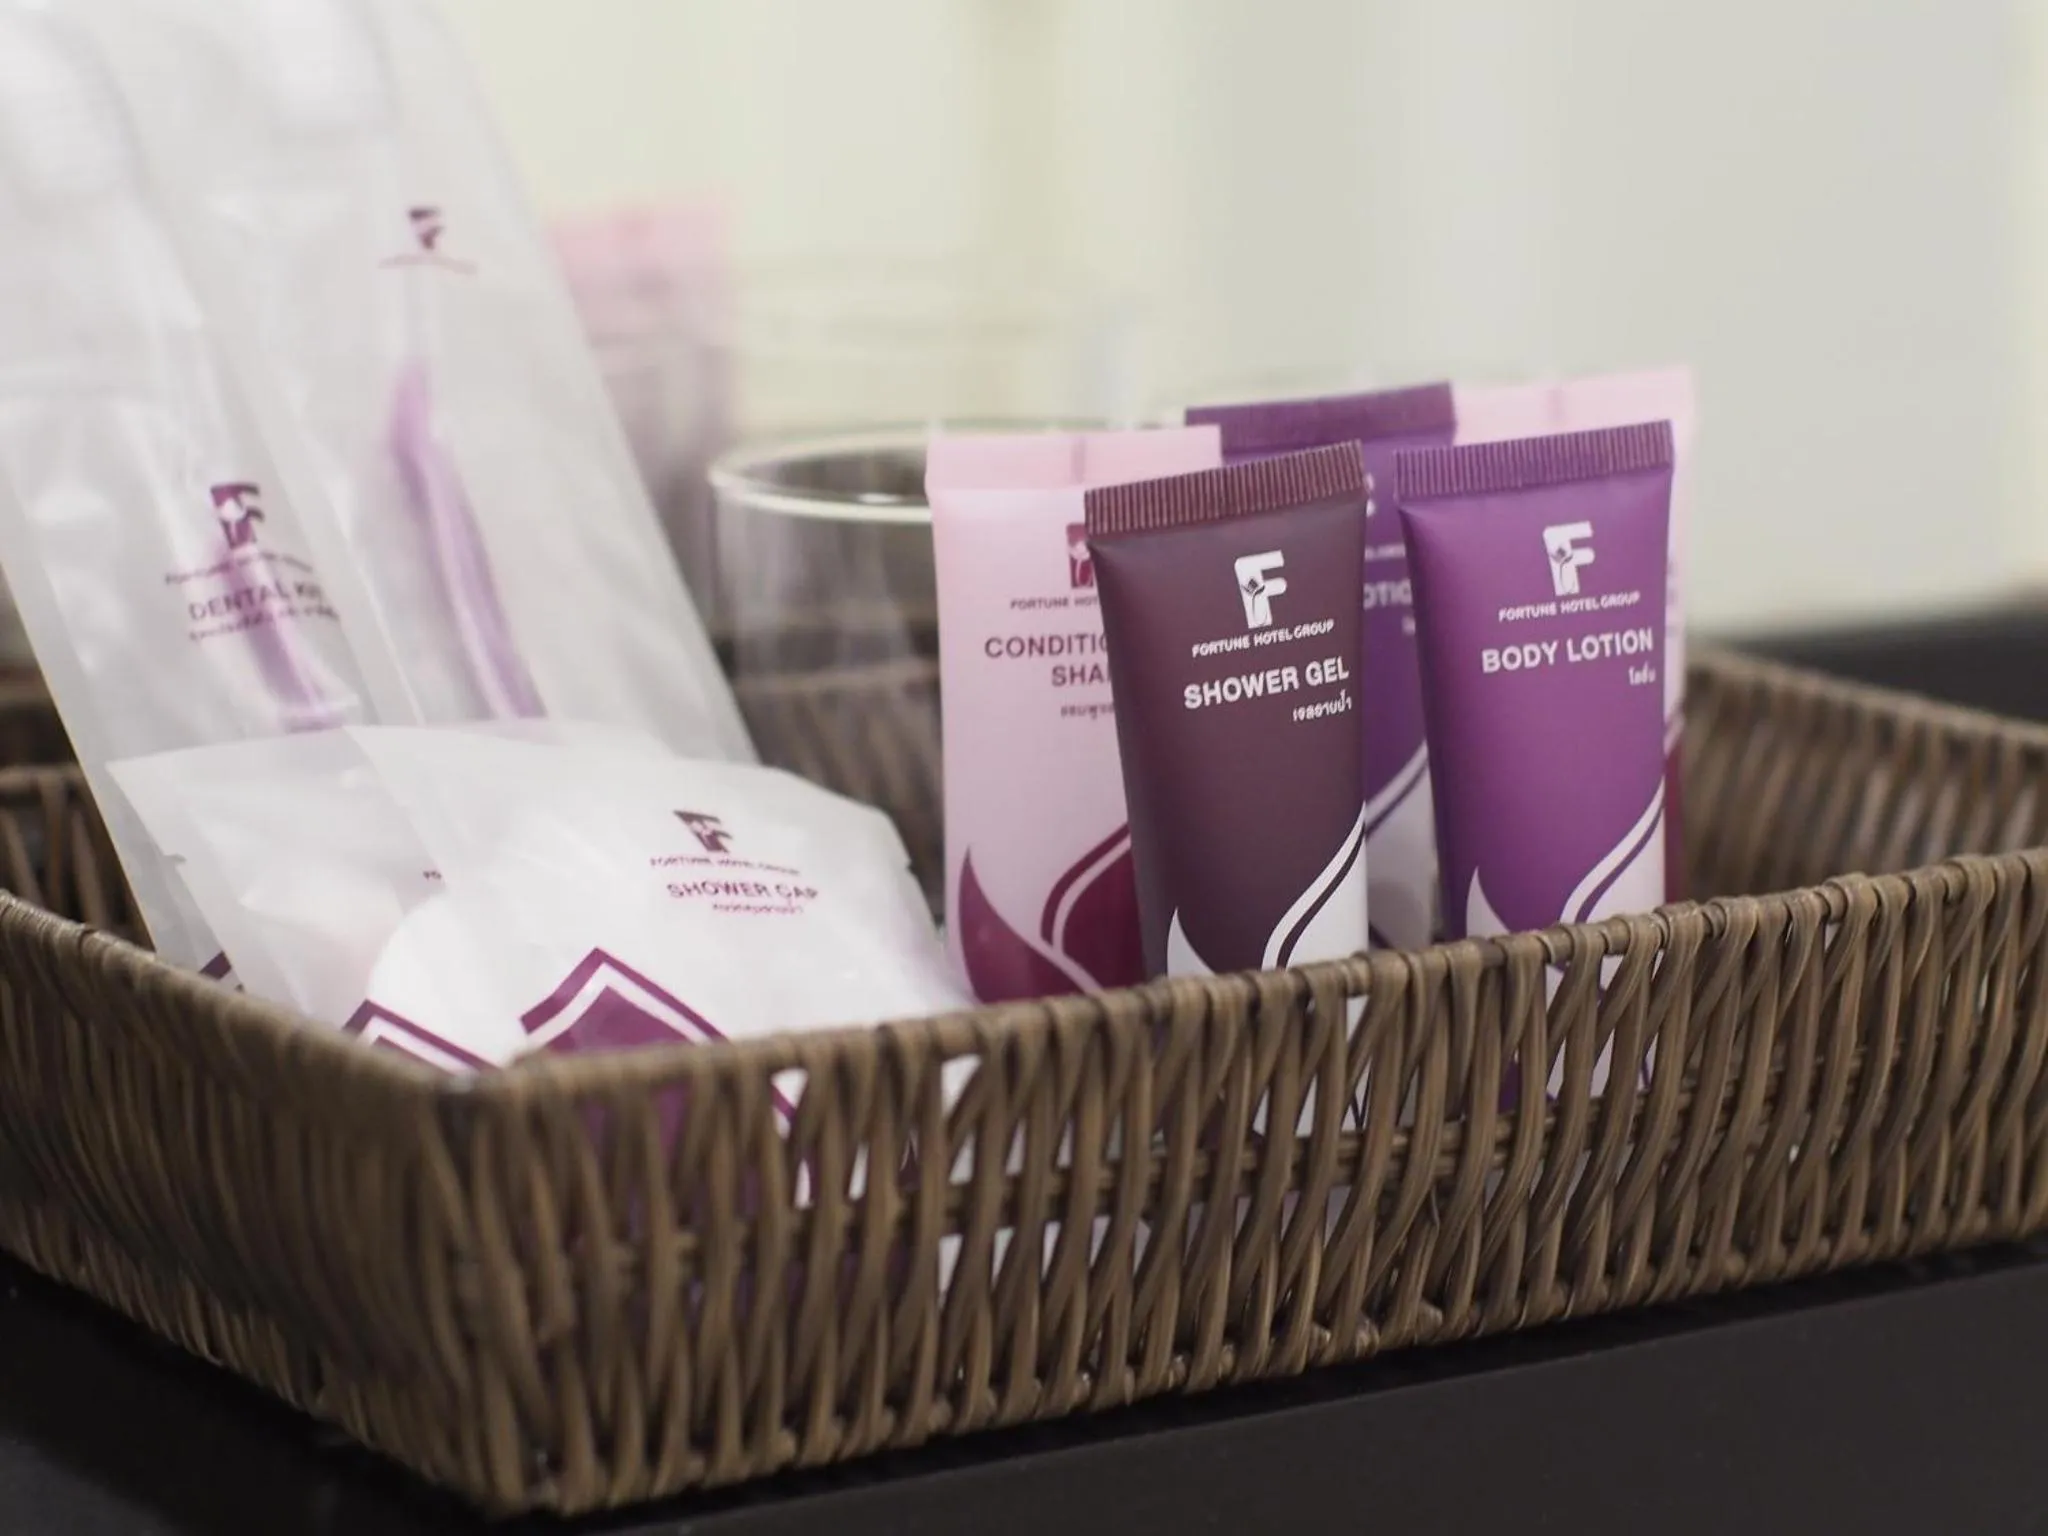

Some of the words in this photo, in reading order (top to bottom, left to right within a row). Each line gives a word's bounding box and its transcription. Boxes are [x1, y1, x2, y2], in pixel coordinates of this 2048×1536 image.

[1543, 520, 1596, 597] F
[189, 580, 290, 621] DENTAL
[1010, 596, 1068, 610] FORTUNE
[1235, 549, 1287, 630] F
[1499, 603, 1557, 622] FORTUNE
[1561, 597, 1599, 615] HOTEL
[1601, 590, 1641, 609] GROUP
[1192, 634, 1250, 658] FORTUNE
[1253, 627, 1293, 646] HOTEL
[1293, 618, 1335, 639] GROUP
[1482, 640, 1559, 674] BODY
[1566, 627, 1654, 662] LOTION
[1051, 662, 1111, 687] SHA
[1183, 665, 1300, 710] SHOWER
[1305, 656, 1350, 686] GEL
[667, 880, 772, 899] SHOWER
[775, 883, 819, 900] CAP
